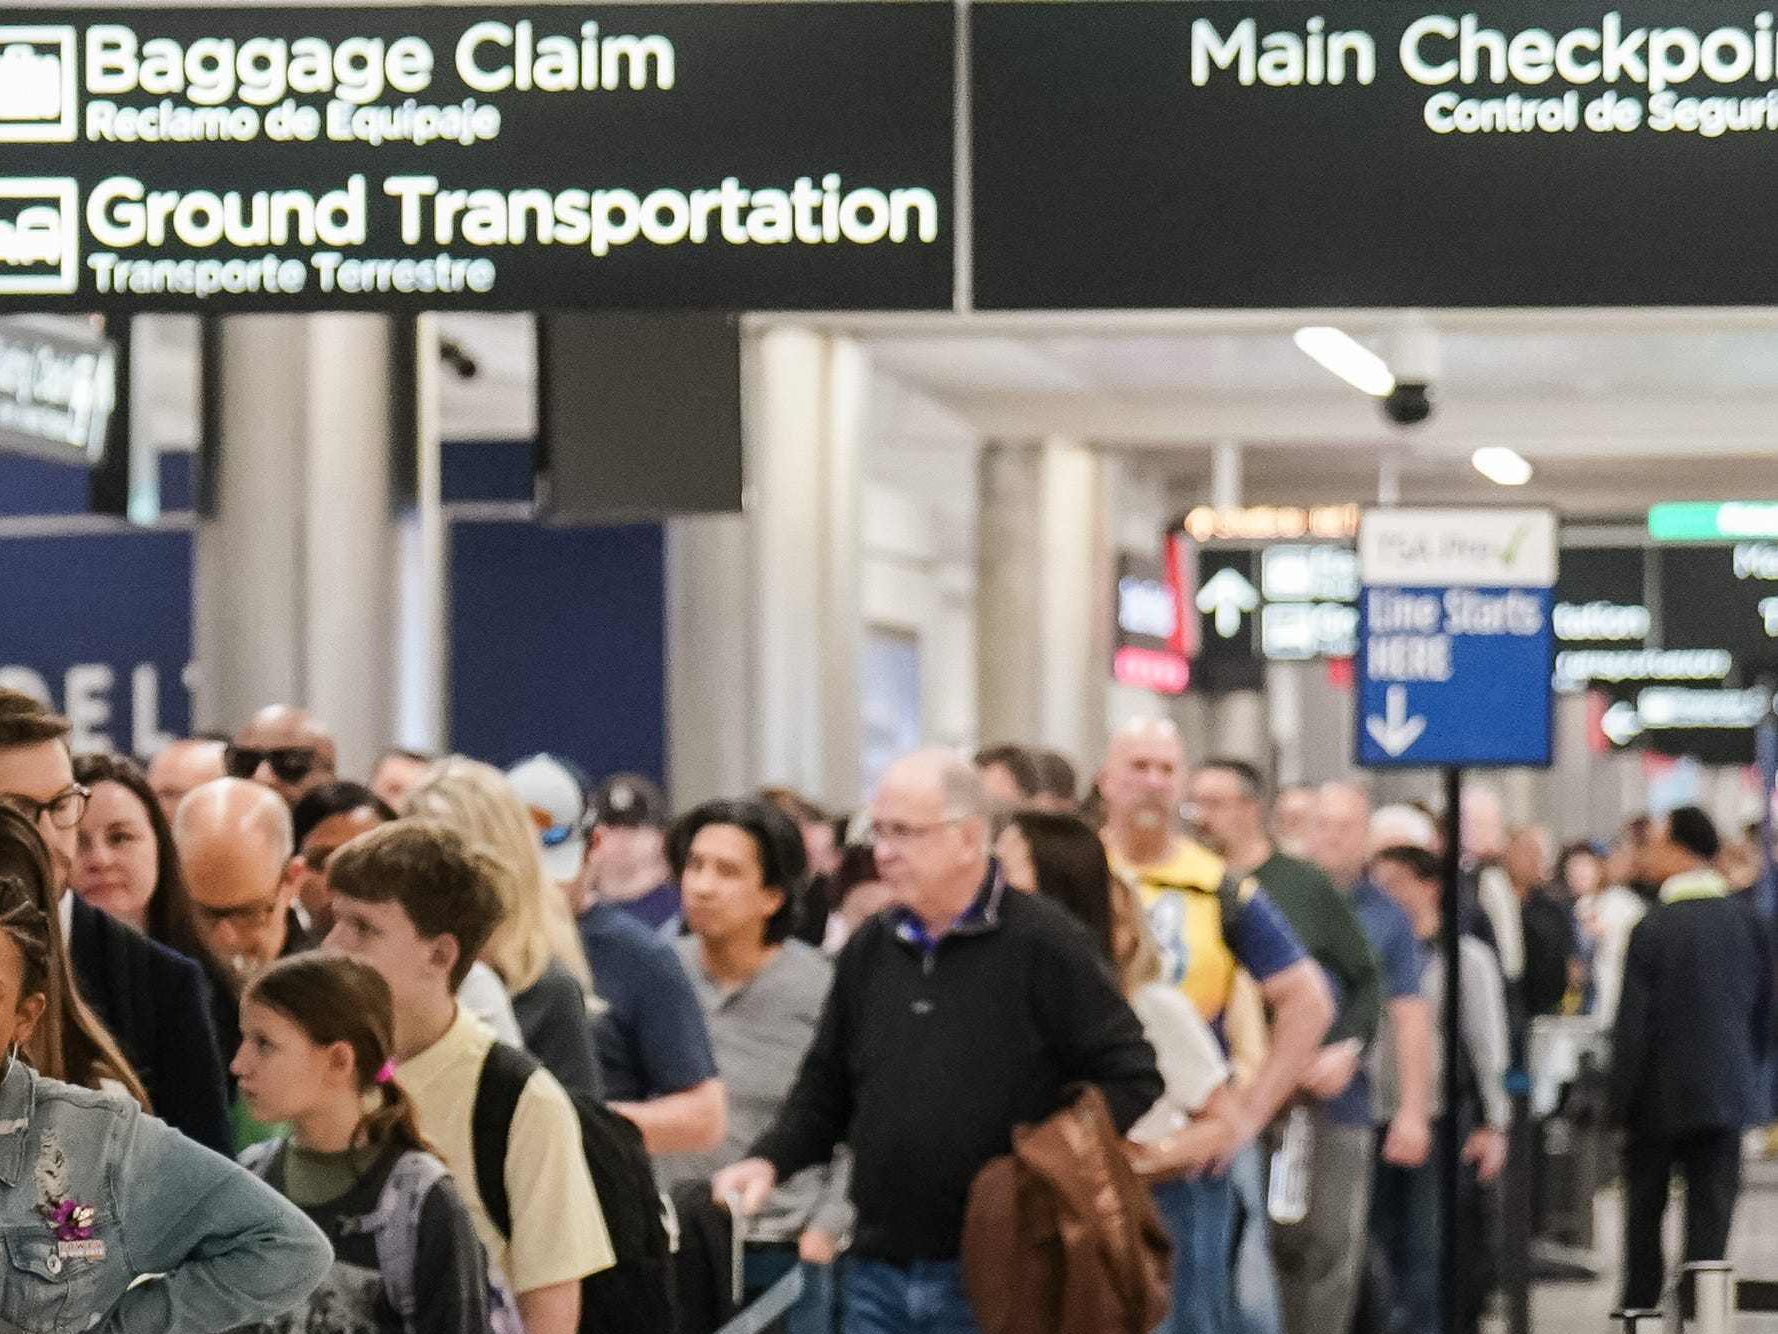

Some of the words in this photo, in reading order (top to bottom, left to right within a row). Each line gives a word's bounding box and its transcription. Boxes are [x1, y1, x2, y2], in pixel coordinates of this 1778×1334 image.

[85, 24, 434, 105] Baggage
[454, 20, 675, 92] Claim
[1190, 15, 1376, 86] Main
[1399, 10, 1778, 94] Checkpoi
[85, 103, 259, 142] Reclamo
[263, 100, 320, 142] de
[326, 100, 502, 146] Equipaje
[1423, 90, 1578, 132] Control
[1583, 90, 1642, 132] de
[85, 173, 368, 248] Ground
[382, 172, 939, 256] Transportation
[86, 253, 307, 298] Transporte
[311, 252, 496, 294] Terrestre
